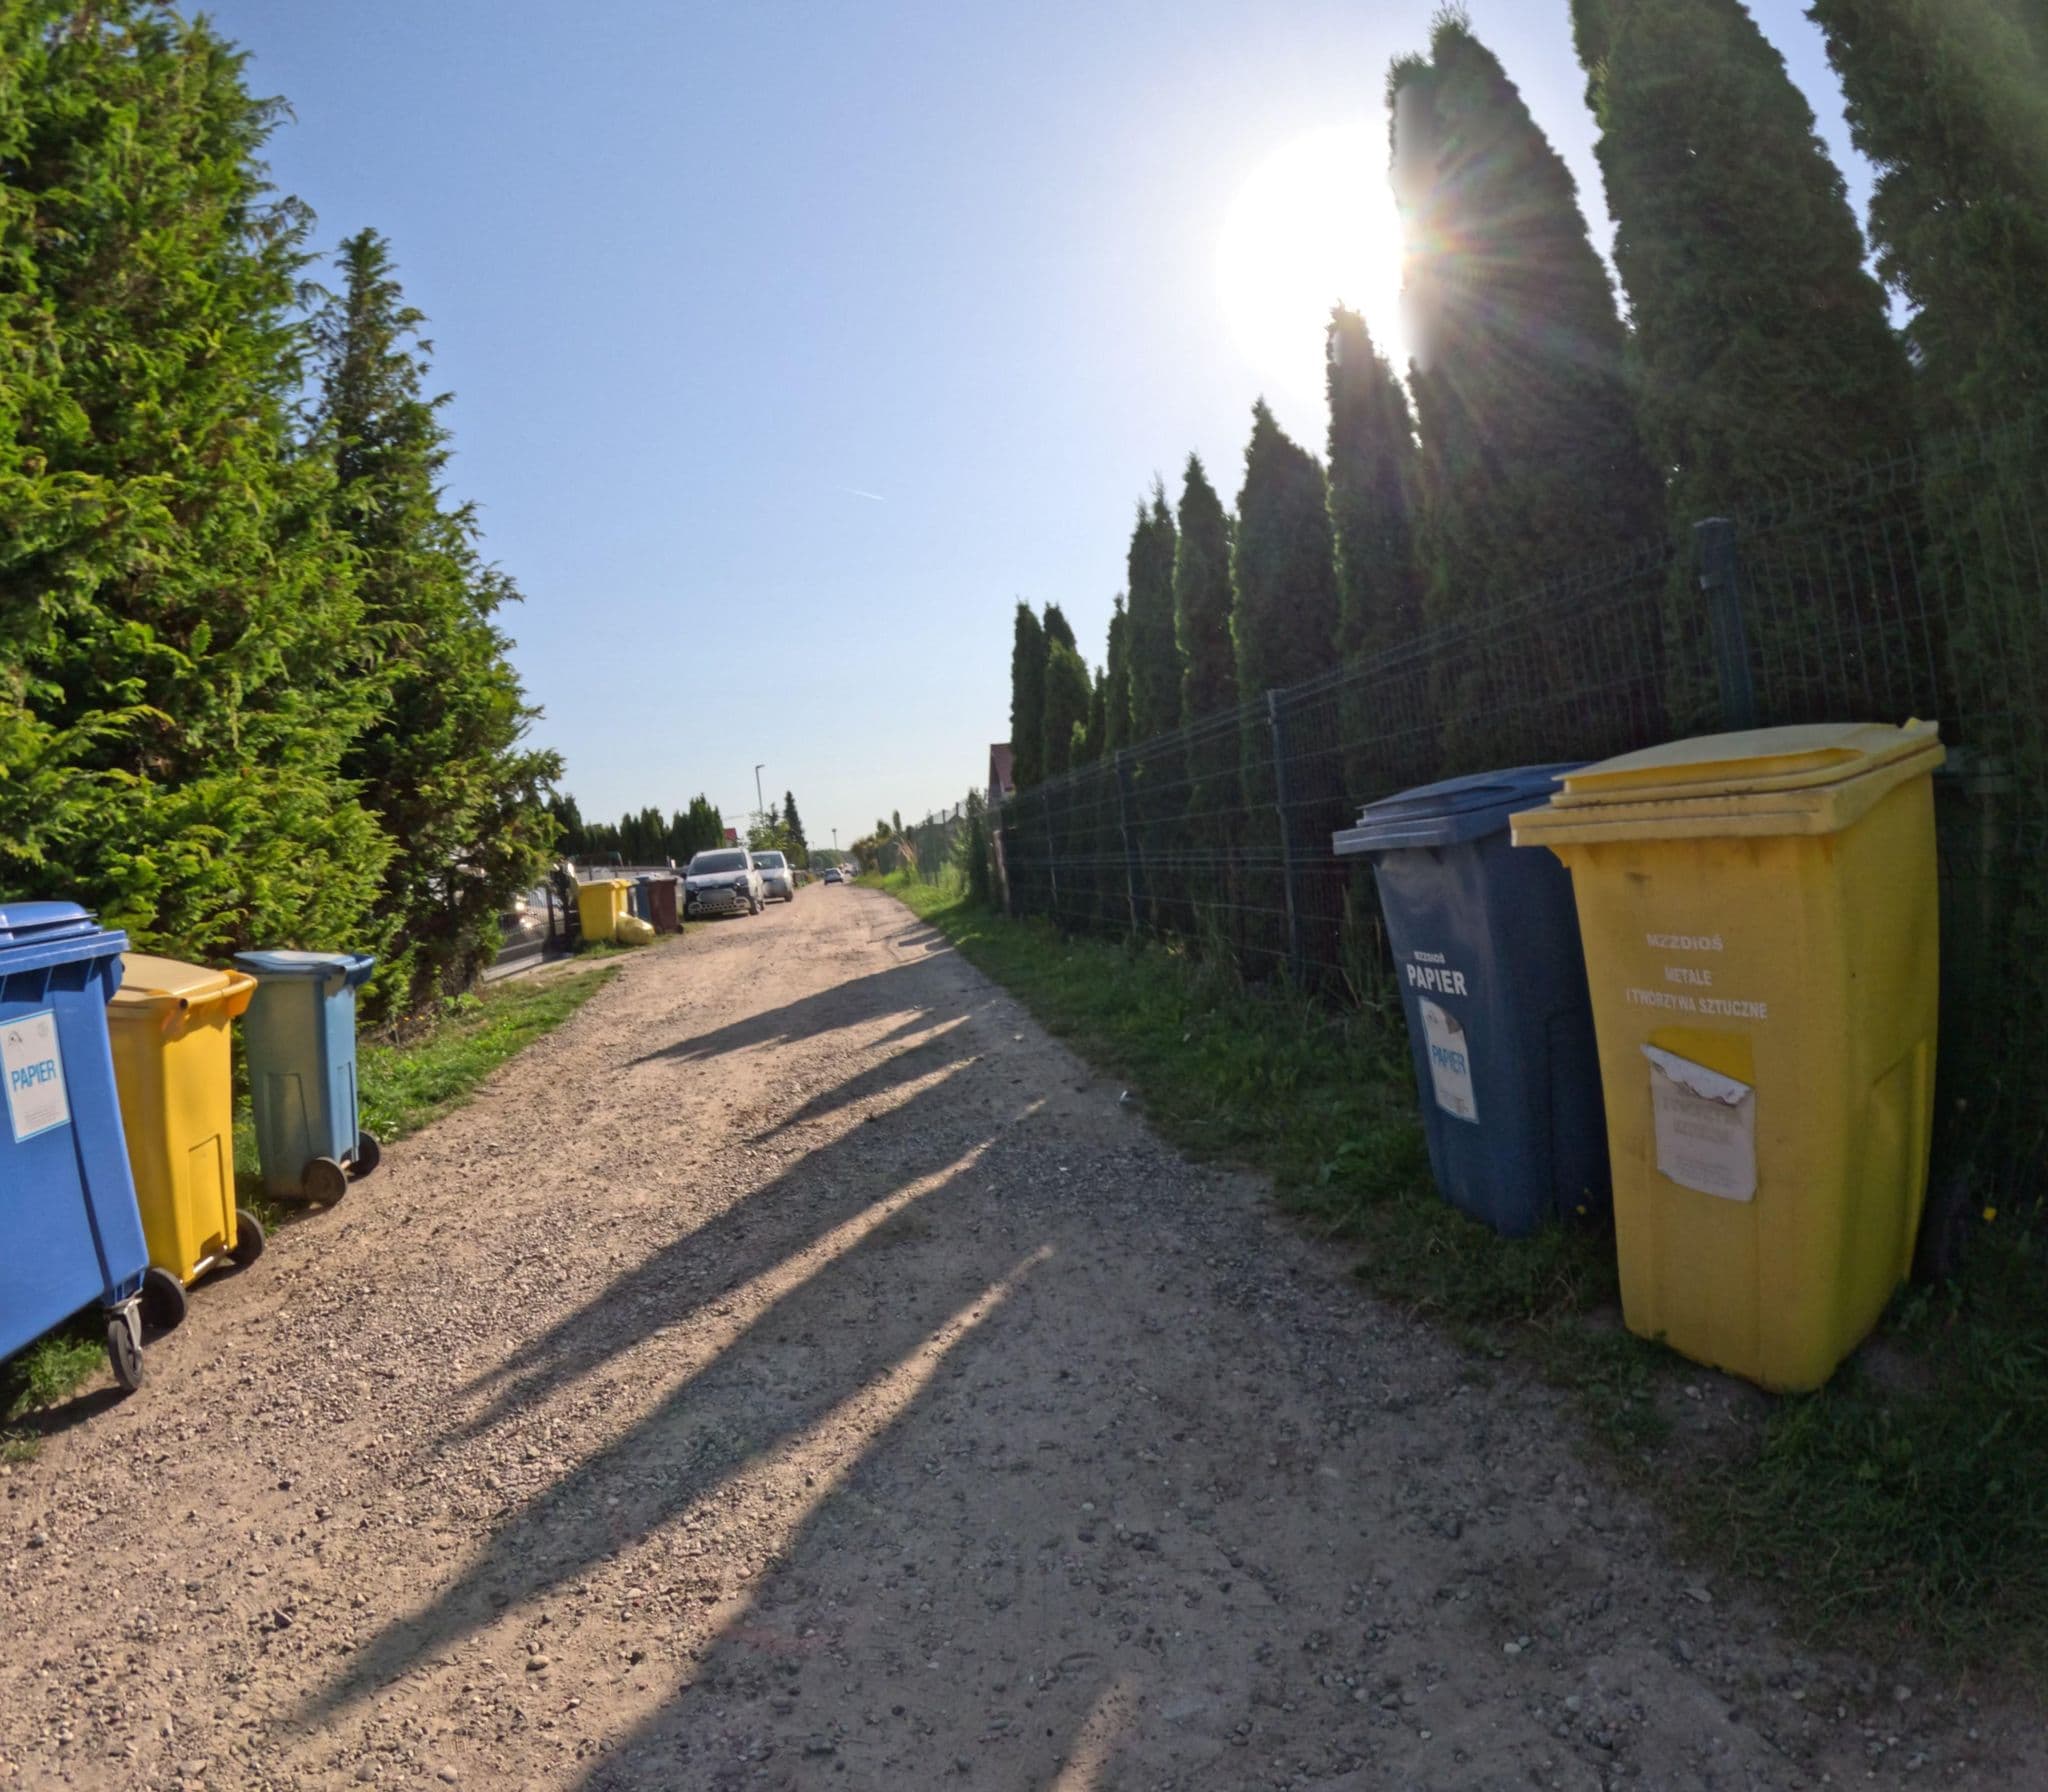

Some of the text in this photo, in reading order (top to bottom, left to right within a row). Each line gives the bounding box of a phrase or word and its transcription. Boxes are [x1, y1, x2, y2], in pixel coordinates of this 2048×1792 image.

[1406, 962, 1468, 996] PAPIER
[1664, 966, 1712, 985] METALE
[1632, 989, 1696, 1011] TWORZYWA
[1699, 998, 1768, 1019] SZTUCZNE
[1432, 1045, 1465, 1074] PAPIER
[11, 1059, 56, 1092] PAPIER
